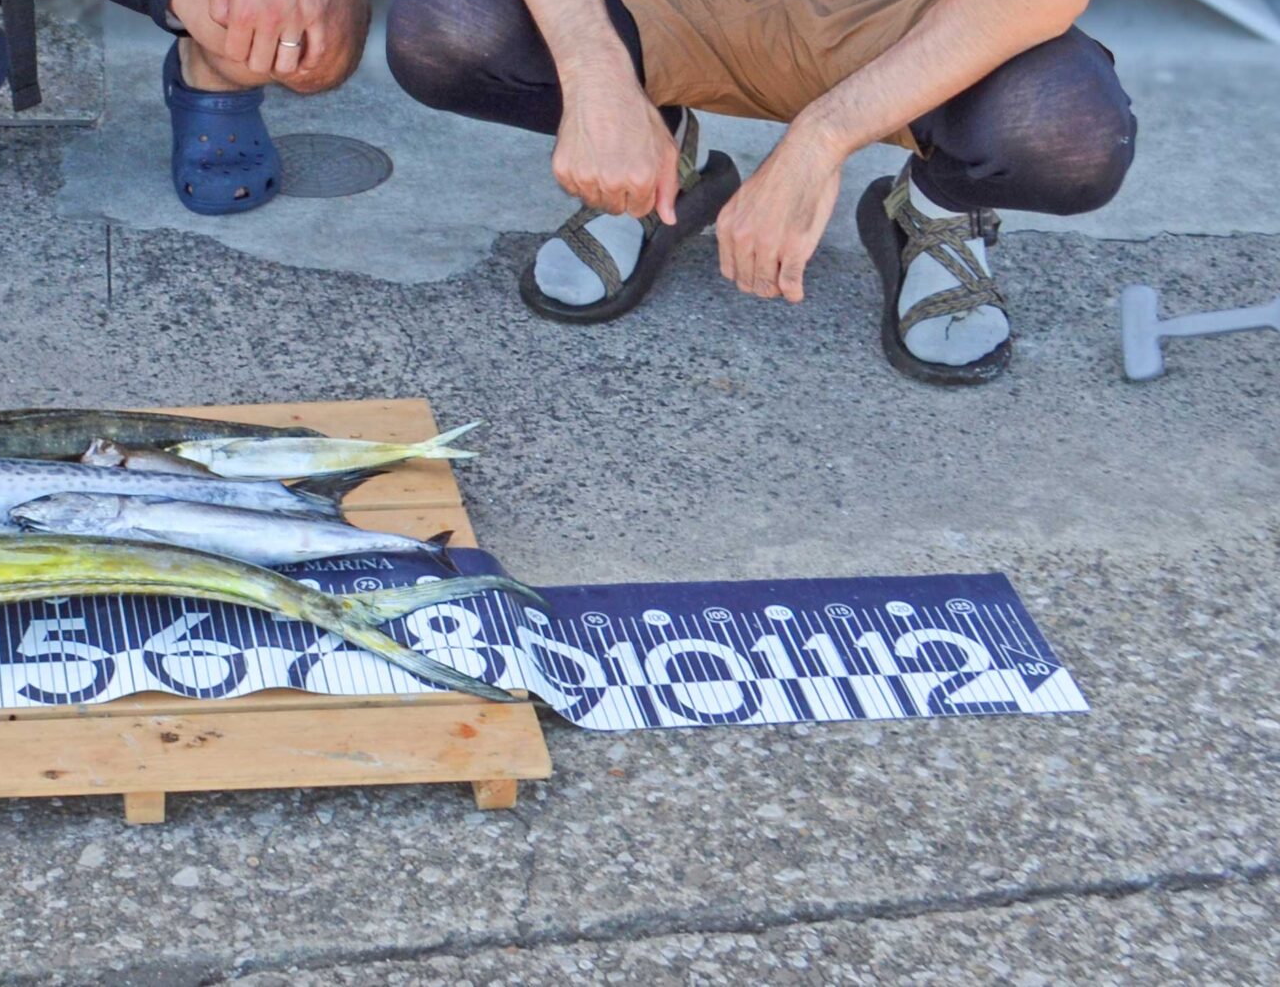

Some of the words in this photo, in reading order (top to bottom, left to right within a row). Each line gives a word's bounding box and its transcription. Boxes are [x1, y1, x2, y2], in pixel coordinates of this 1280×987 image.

[303, 556, 395, 572] MARINA
[359, 579, 377, 590] 75
[707, 610, 729, 620] 105
[829, 606, 850, 616] 115
[16, 616, 117, 705] 5
[143, 612, 249, 700] 6
[406, 603, 507, 692] 8
[516, 625, 608, 722] 9
[604, 639, 763, 729] 10
[1017, 662, 1051, 677] 130
